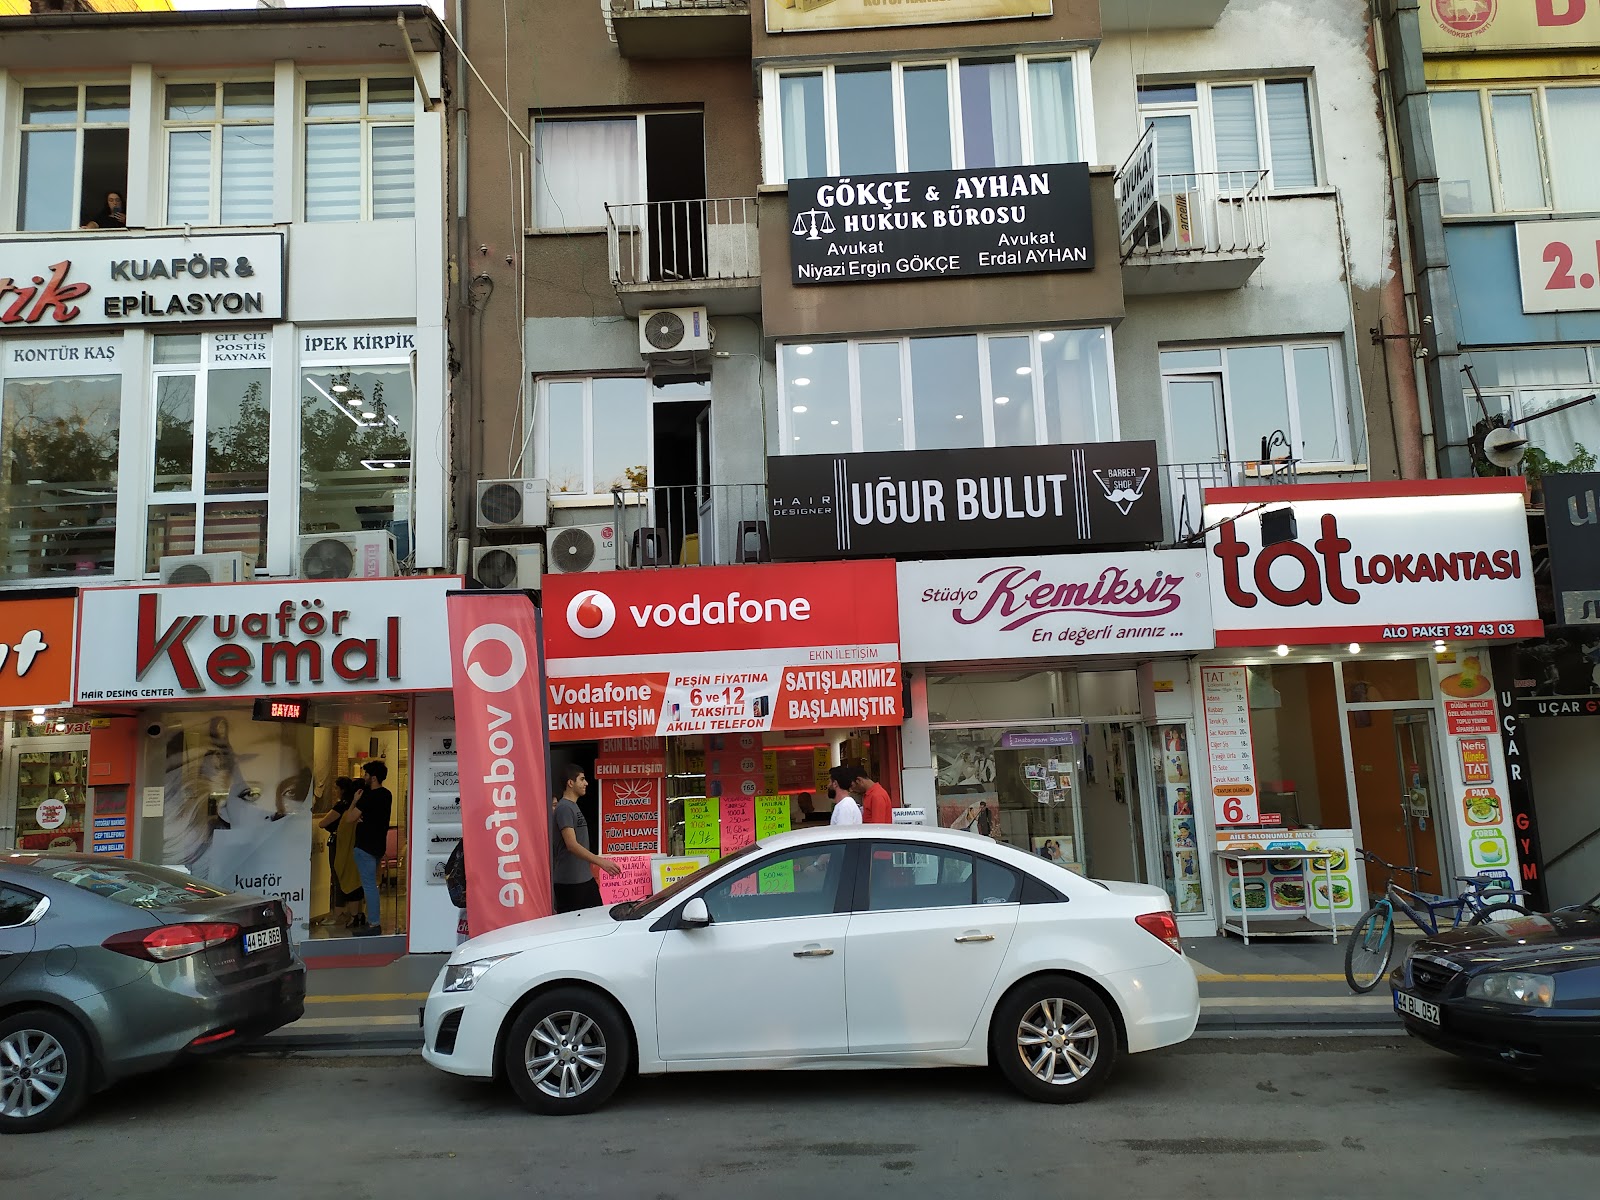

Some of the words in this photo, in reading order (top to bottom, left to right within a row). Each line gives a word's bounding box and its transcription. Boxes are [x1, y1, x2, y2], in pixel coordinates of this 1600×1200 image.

[1439, 23, 1473, 39] DEMOKRAT
[1121, 142, 1153, 207] AVUKAT
[816, 178, 911, 210] GÖKÇE
[925, 186, 940, 202] &
[954, 172, 1050, 200] AYHAN
[844, 210, 928, 233] HUKUK
[933, 205, 1026, 229] BÜROSU
[998, 230, 1055, 247] Avukat
[827, 240, 884, 256] Avukat
[978, 250, 1022, 267] Erdal
[1025, 247, 1087, 264] AYHAN
[110, 253, 230, 283] KUAFÖR
[235, 256, 255, 278] &
[797, 261, 846, 281] Niyazi
[848, 260, 890, 279] Ergin
[895, 255, 960, 275] GÖKÇE
[104, 290, 264, 318] EPİLASYON
[215, 341, 266, 352] POSTİŞ
[305, 334, 348, 352] İPEK
[353, 332, 415, 351] KİRPİK
[13, 346, 80, 363] KONTÜR
[84, 345, 115, 364] KAŞ
[215, 352, 267, 362] KAYNAK
[1108, 467, 1136, 478] BARBER
[1113, 479, 1132, 490] SHOP
[773, 495, 831, 507] HAIR
[851, 476, 945, 526] UĞUR
[957, 473, 1067, 522] BULUT
[773, 507, 832, 516] DESIGNER
[602, 541, 613, 549] LG
[1214, 513, 1360, 609] tat
[1355, 549, 1521, 585] LOKANTASI
[921, 587, 978, 605] Stüdyo
[952, 565, 1185, 631] Kemiksiz
[629, 592, 811, 628] vodafone
[1032, 628, 1052, 642] En
[1058, 625, 1112, 646] değerli
[1116, 626, 1165, 639] anınız
[1383, 626, 1408, 639] ALO
[1412, 625, 1450, 638] PAKET
[1454, 625, 1475, 636] 321
[1478, 624, 1495, 636] 43
[1498, 623, 1516, 635] 03
[809, 648, 833, 661] EKİN
[835, 646, 878, 661] İLETİŞİM
[675, 674, 710, 688] PEŞİN
[714, 672, 768, 685] FİYATINA
[786, 667, 897, 694] SATIŞLARIMIZ
[1204, 671, 1225, 682] TAT
[141, 687, 175, 697] CENTER
[550, 681, 651, 705] Vodafone
[690, 688, 702, 707] 6
[705, 693, 719, 703] ve
[721, 686, 745, 706] 12
[271, 703, 300, 718] BAYAN
[690, 704, 745, 717] TAKSİTLİ
[788, 696, 896, 724] BAŞLAMIŞTIR
[1539, 701, 1580, 716] UÇAR
[548, 709, 584, 731] EKİN
[590, 705, 655, 731] İLETİŞİM
[666, 720, 707, 733] AKILLI
[710, 717, 764, 731] TELEFON
[45, 721, 91, 735] Hyat
[1462, 742, 1486, 750] Nefis
[597, 763, 620, 775] EKİN
[1465, 763, 1489, 775] TAT
[615, 797, 651, 806] HUAWEI
[1471, 788, 1490, 799] PAÇA
[432, 803, 462, 812] Schwarzkop
[605, 813, 627, 824] SATIŞ
[629, 812, 658, 821] NOKTAS
[605, 828, 622, 838] TÜM
[624, 828, 658, 837] HUAWE
[1230, 831, 1246, 840] AİLE
[1247, 832, 1294, 840] SALONUMUZ
[1474, 829, 1498, 839] ÇORBA
[607, 841, 658, 852] MODELLERDE
[1516, 812, 1538, 880] GYM
[235, 873, 282, 889] kuaför
[263, 888, 304, 902] mal
[247, 934, 256, 950] 44
[257, 932, 268, 947] BZ
[1397, 992, 1408, 1012] 44
[1408, 997, 1420, 1016] BL
[1421, 1002, 1440, 1023] 052
